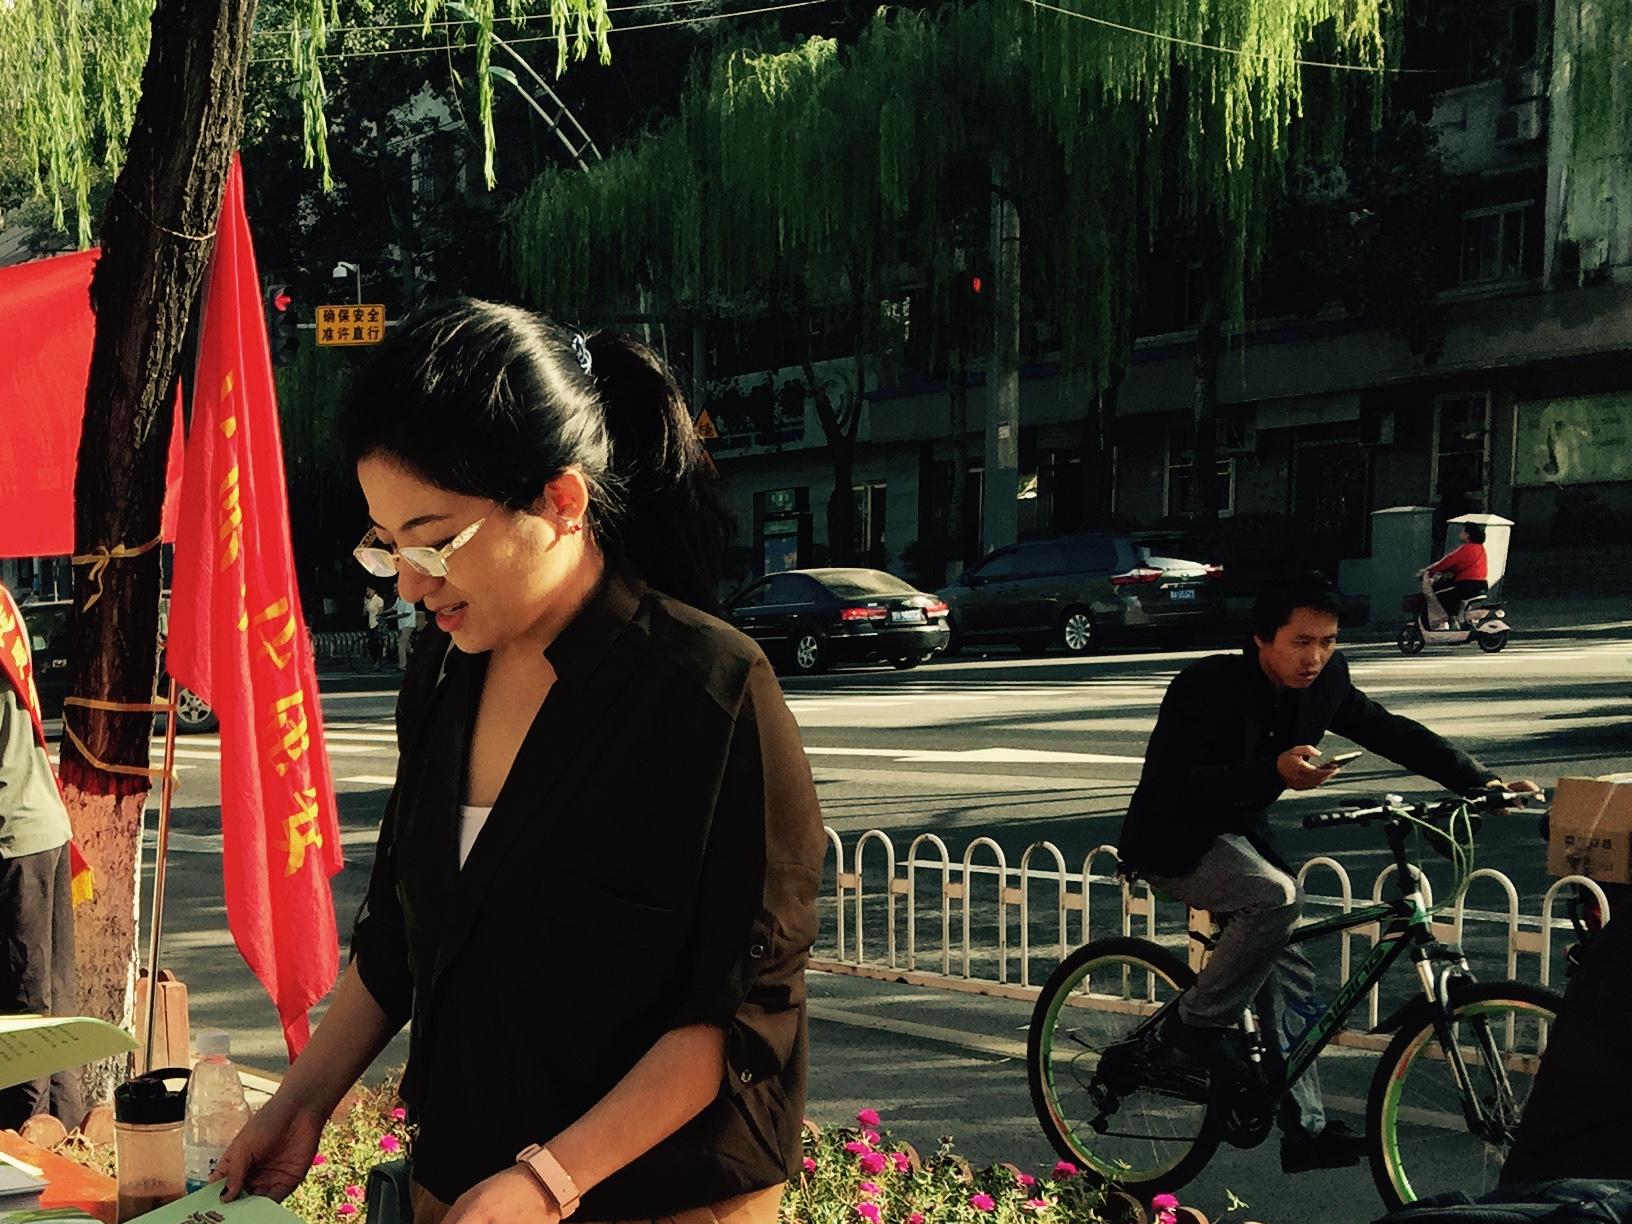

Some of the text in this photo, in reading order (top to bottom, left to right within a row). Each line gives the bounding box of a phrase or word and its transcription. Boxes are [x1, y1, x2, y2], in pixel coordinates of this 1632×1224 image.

[323, 308, 380, 323] 确保安全
[322, 326, 380, 341] 准许直行
